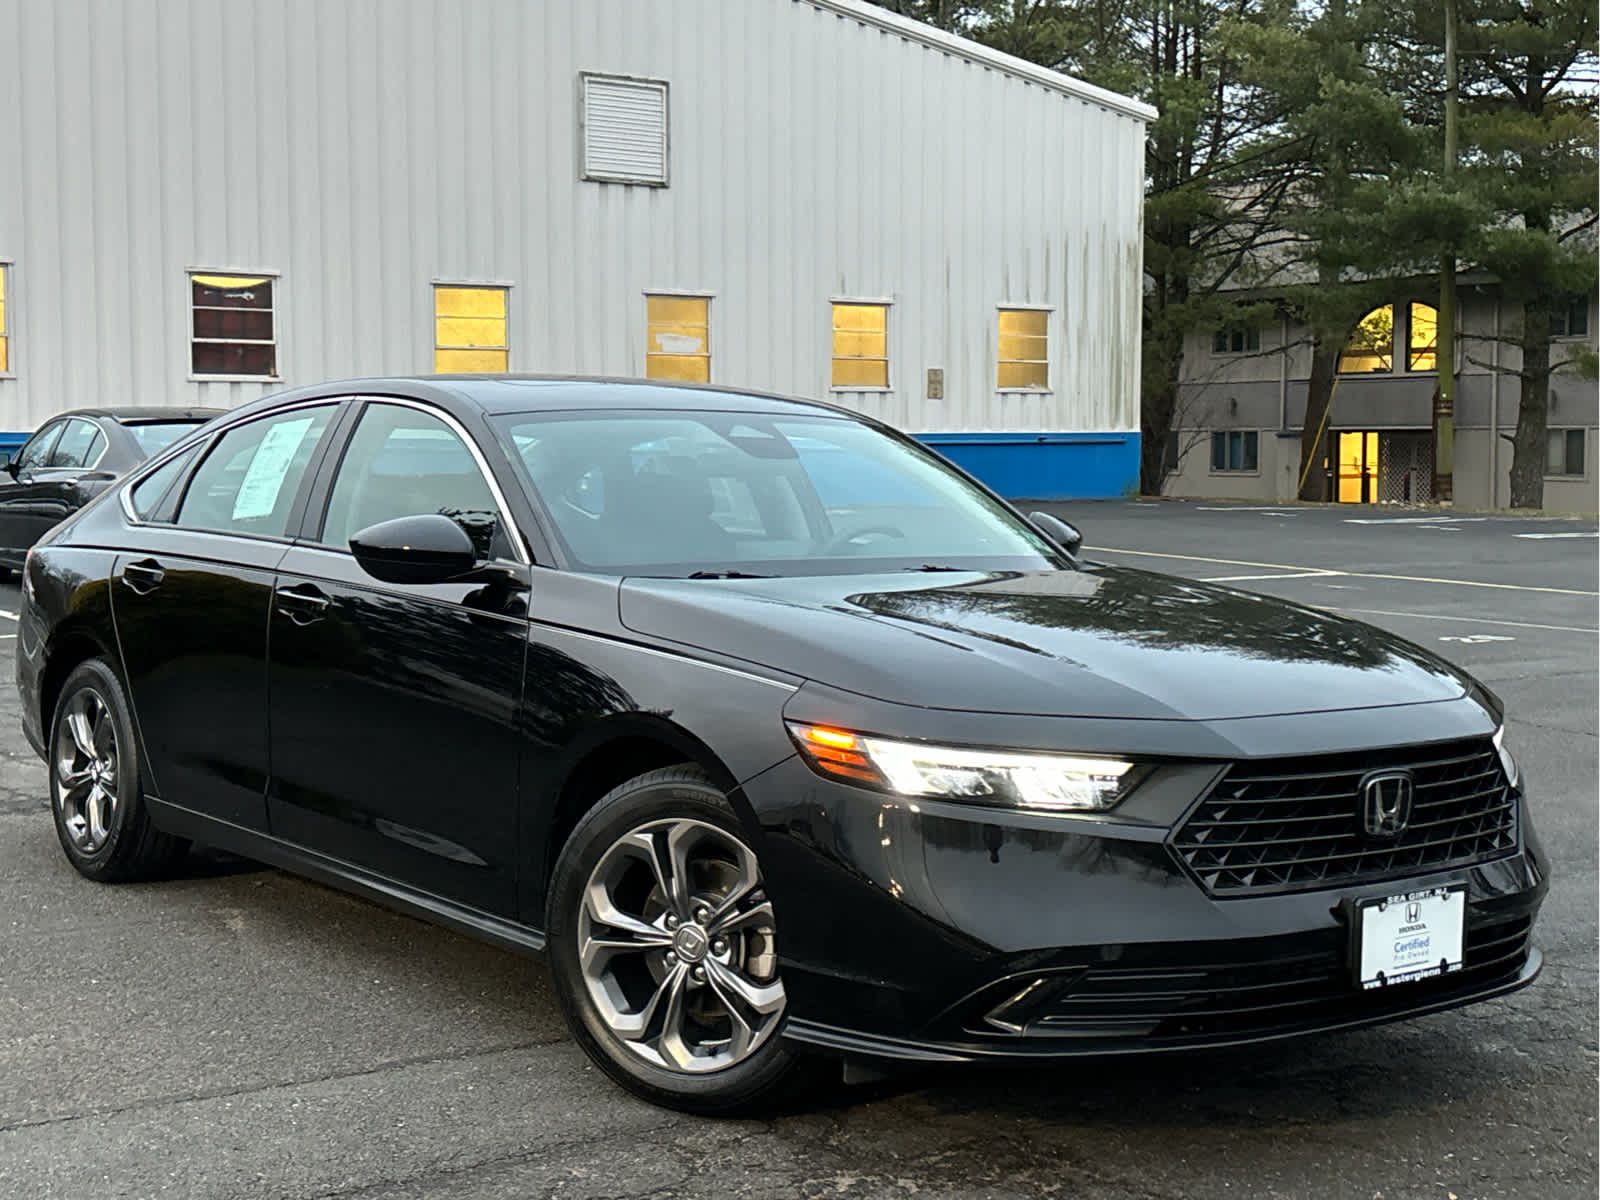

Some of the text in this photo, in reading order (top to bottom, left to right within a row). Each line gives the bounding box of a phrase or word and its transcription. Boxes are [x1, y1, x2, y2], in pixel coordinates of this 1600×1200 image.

[1387, 894, 1406, 904] SEA
[1398, 923, 1426, 934] HONDA
[1394, 936, 1430, 953] Certified
